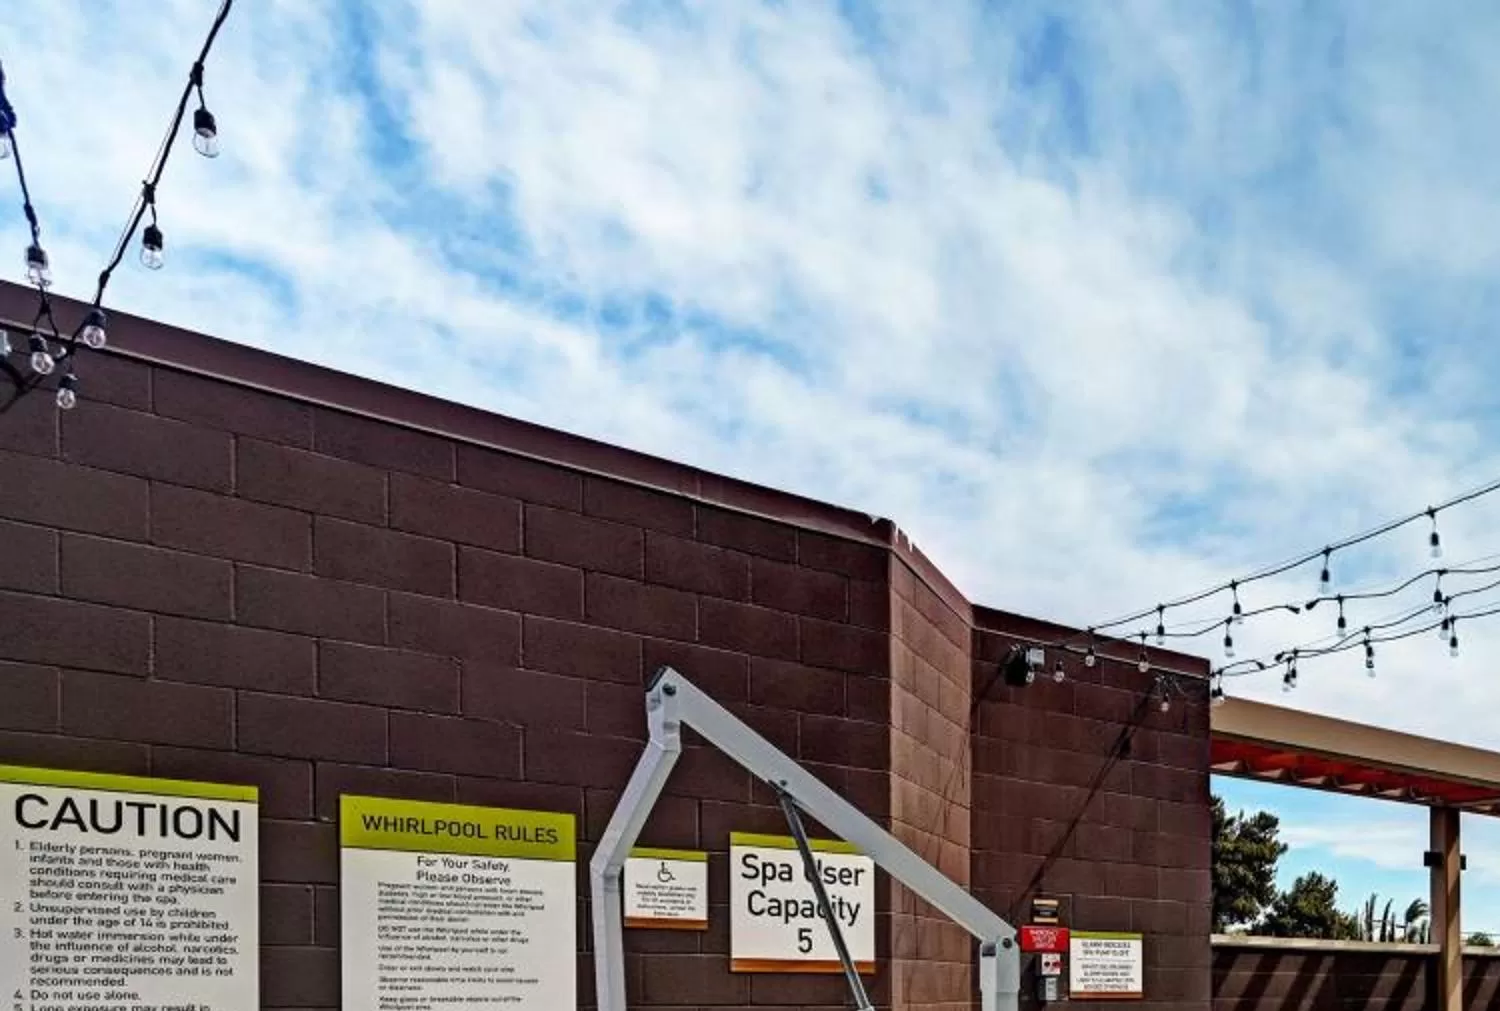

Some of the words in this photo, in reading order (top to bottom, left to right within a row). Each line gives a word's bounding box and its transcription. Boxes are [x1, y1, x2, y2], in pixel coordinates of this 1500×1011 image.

[15, 794, 239, 842] CAUTION
[362, 814, 488, 839] WHIRLPOOL
[496, 825, 558, 844] RULES
[30, 842, 76, 854] Elderly
[139, 849, 192, 860] pregnant
[30, 854, 74, 865] infants
[78, 857, 102, 867] and
[106, 858, 141, 868] those
[144, 860, 169, 869] with
[173, 861, 210, 871] health
[417, 856, 437, 866] For
[441, 858, 468, 869] Your
[30, 867, 95, 877] conditions
[100, 869, 156, 882] requiring
[161, 873, 207, 883] medical
[211, 876, 236, 884] care
[741, 854, 792, 886] Spa
[416, 871, 458, 882] Please
[462, 873, 511, 886] Observe
[30, 878, 74, 889] should
[78, 881, 123, 891] consult
[128, 882, 153, 891] with
[169, 884, 224, 896] physician
[30, 890, 72, 899] before
[76, 891, 128, 904] entering
[133, 892, 151, 902] the
[30, 904, 120, 918] Unsupervised
[150, 908, 164, 918] by
[168, 909, 216, 918] children
[748, 890, 860, 926] Capacity
[30, 916, 68, 925] under
[74, 916, 92, 926] the
[97, 919, 120, 928] age
[124, 918, 137, 927] of
[140, 918, 152, 927] 14
[156, 920, 166, 928] is
[30, 930, 52, 939] Hot
[57, 931, 93, 939] water
[98, 931, 164, 941] immersion
[169, 933, 200, 942] while
[204, 934, 238, 943] under
[798, 928, 812, 953] 5
[30, 942, 50, 950] the
[55, 942, 114, 951] influence
[118, 942, 130, 952] of
[30, 953, 68, 964] drugs
[91, 955, 154, 964] medicines
[159, 956, 185, 965] may
[188, 955, 212, 964] lead
[216, 956, 227, 964] to
[30, 966, 78, 974] serious
[83, 967, 172, 977] consequences
[176, 966, 198, 975] and
[202, 967, 212, 975] is
[216, 967, 233, 975] not
[30, 990, 48, 1000] Do
[53, 991, 73, 1000] not
[77, 992, 100, 1000] use
[161, 1004, 195, 1011] result
